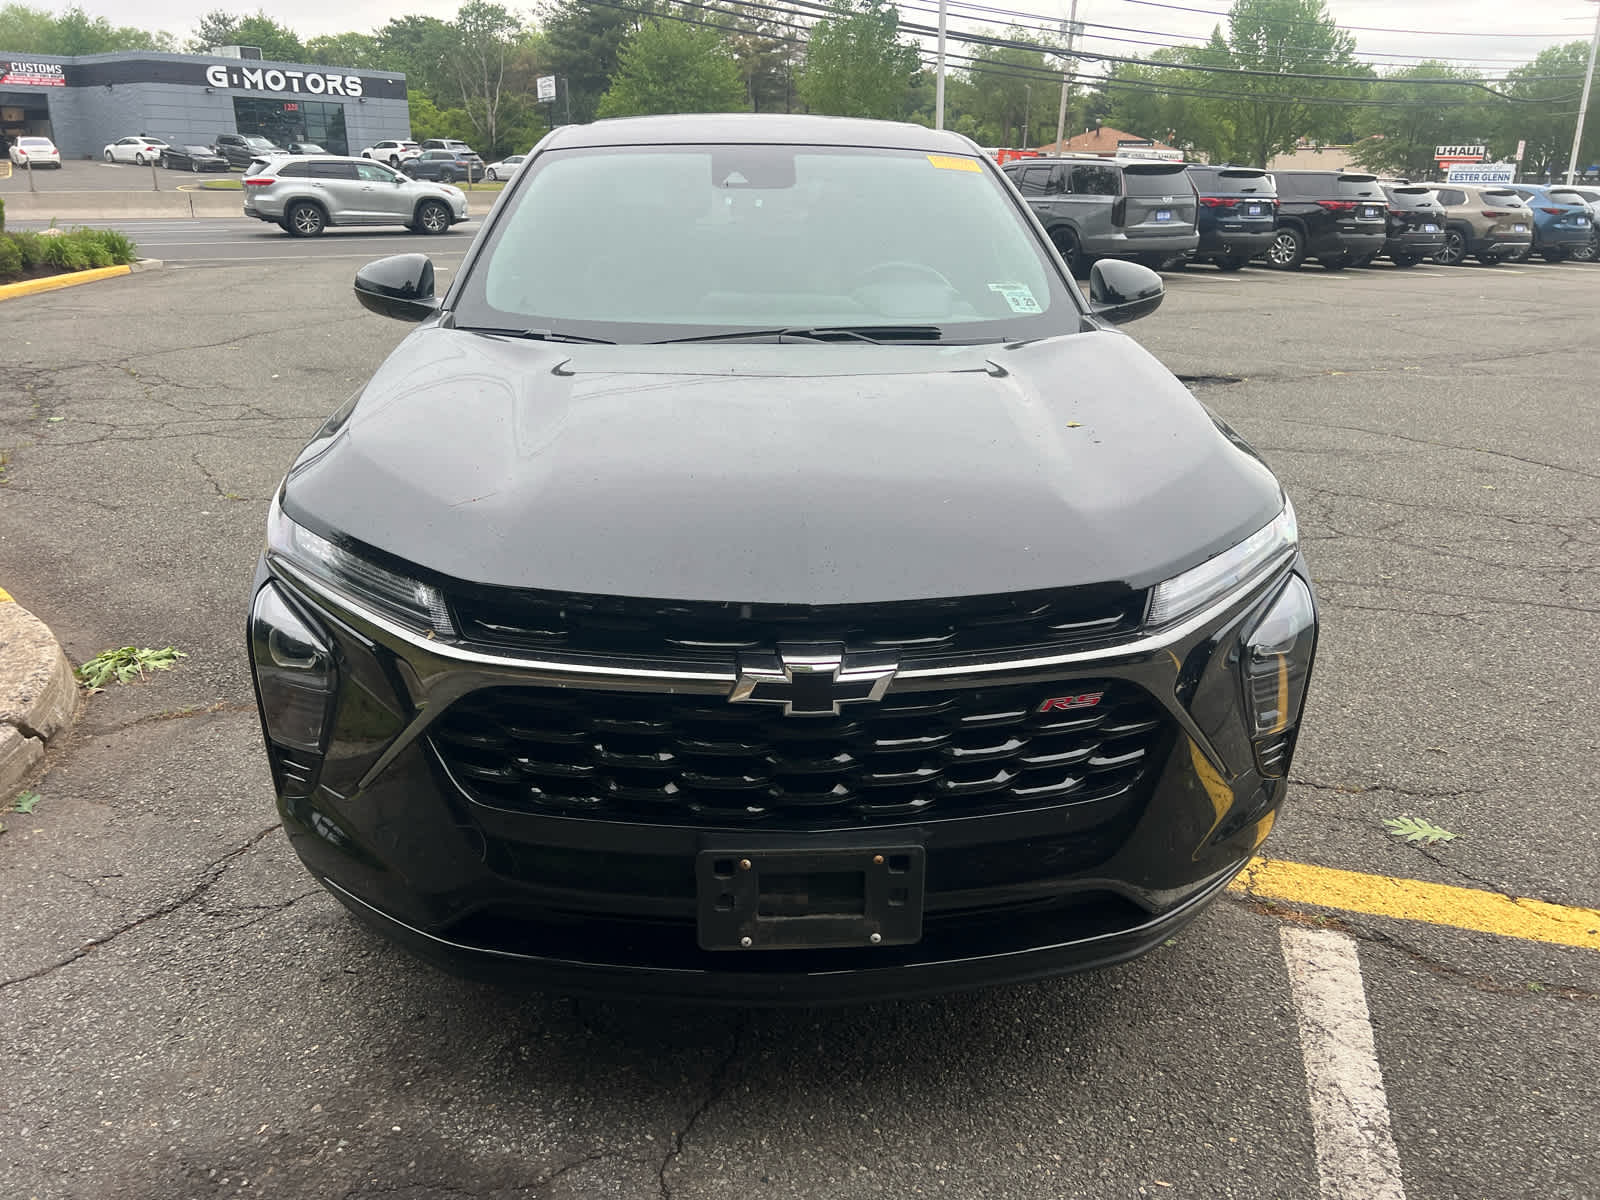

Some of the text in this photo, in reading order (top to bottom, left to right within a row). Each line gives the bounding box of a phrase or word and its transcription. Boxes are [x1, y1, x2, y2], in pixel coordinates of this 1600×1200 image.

[11, 62, 63, 74] CUSTOMS
[1436, 146, 1483, 156] U-HAUL
[1449, 173, 1511, 181] LESTER GLENN
[1037, 692, 1104, 712] RS
